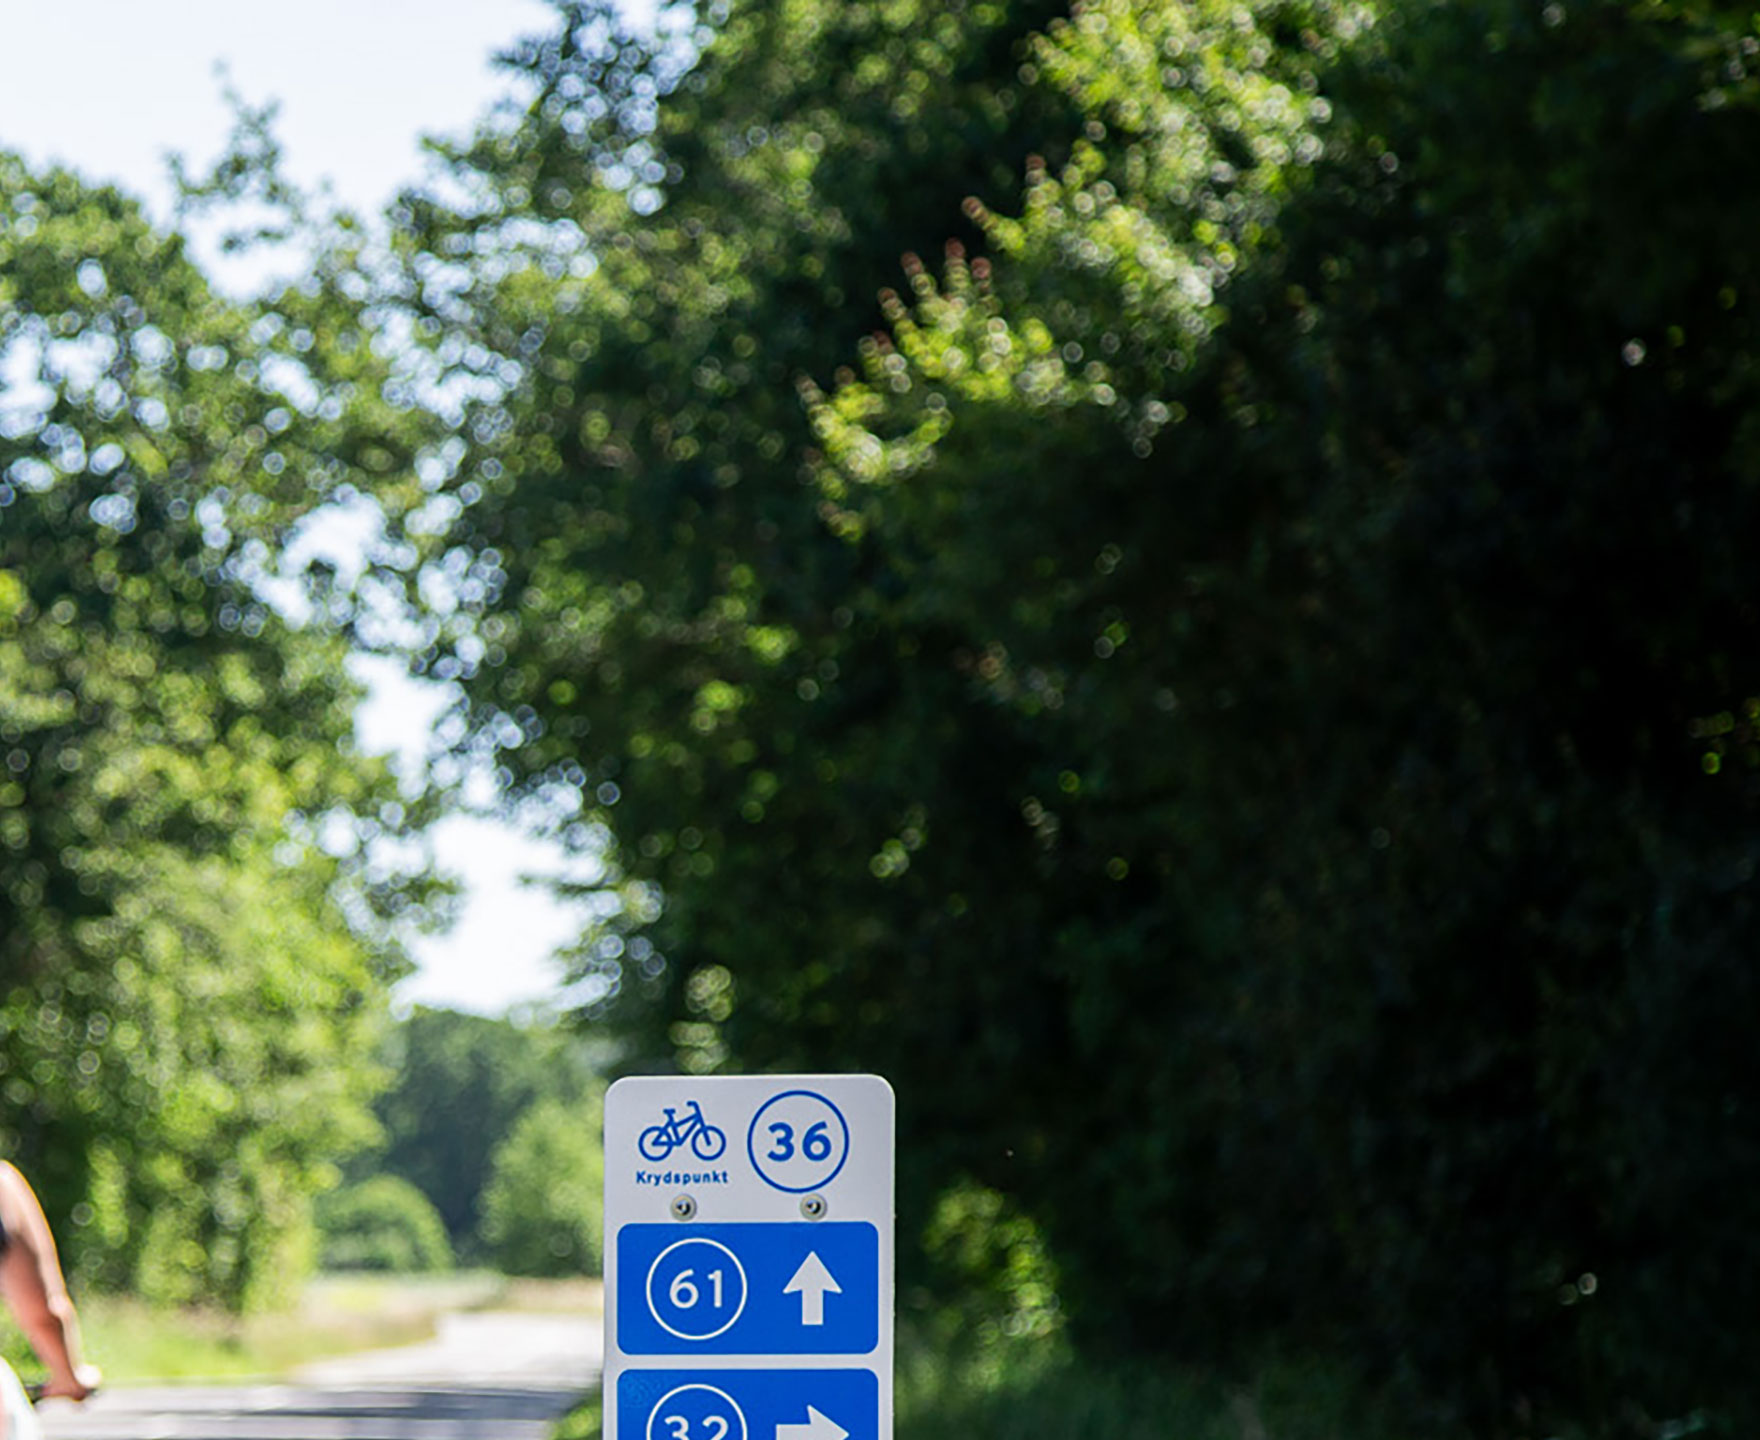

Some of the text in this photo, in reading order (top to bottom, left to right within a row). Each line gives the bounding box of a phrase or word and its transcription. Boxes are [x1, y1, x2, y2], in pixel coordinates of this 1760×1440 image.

[767, 1121, 832, 1162] 36
[636, 1171, 728, 1186] Krydspunkt
[669, 1269, 723, 1309] 61
